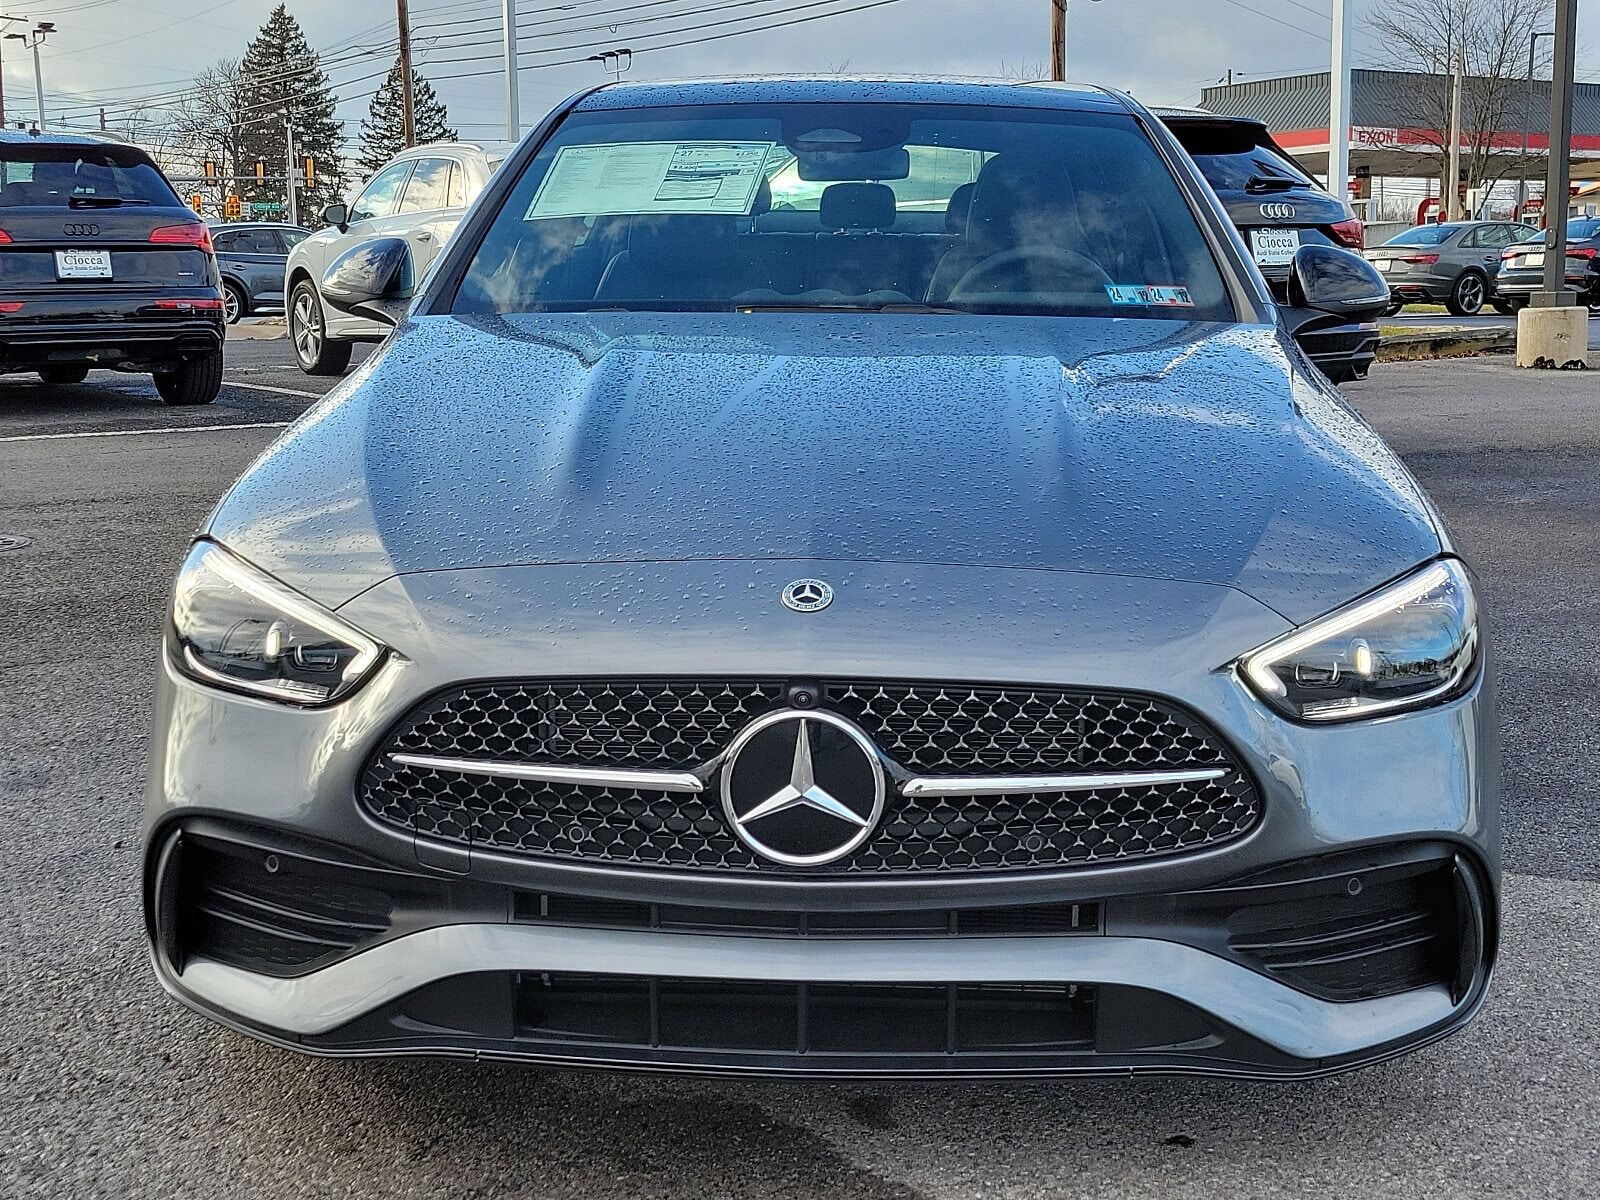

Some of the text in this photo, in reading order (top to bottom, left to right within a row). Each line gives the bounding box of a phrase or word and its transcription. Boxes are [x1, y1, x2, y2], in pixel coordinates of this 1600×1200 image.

[1358, 130, 1393, 145] EXXON
[1257, 235, 1293, 248] Ciocca
[64, 255, 103, 265] Ciocca
[1109, 287, 1152, 302] 24 12
[1151, 288, 1165, 302] 24
